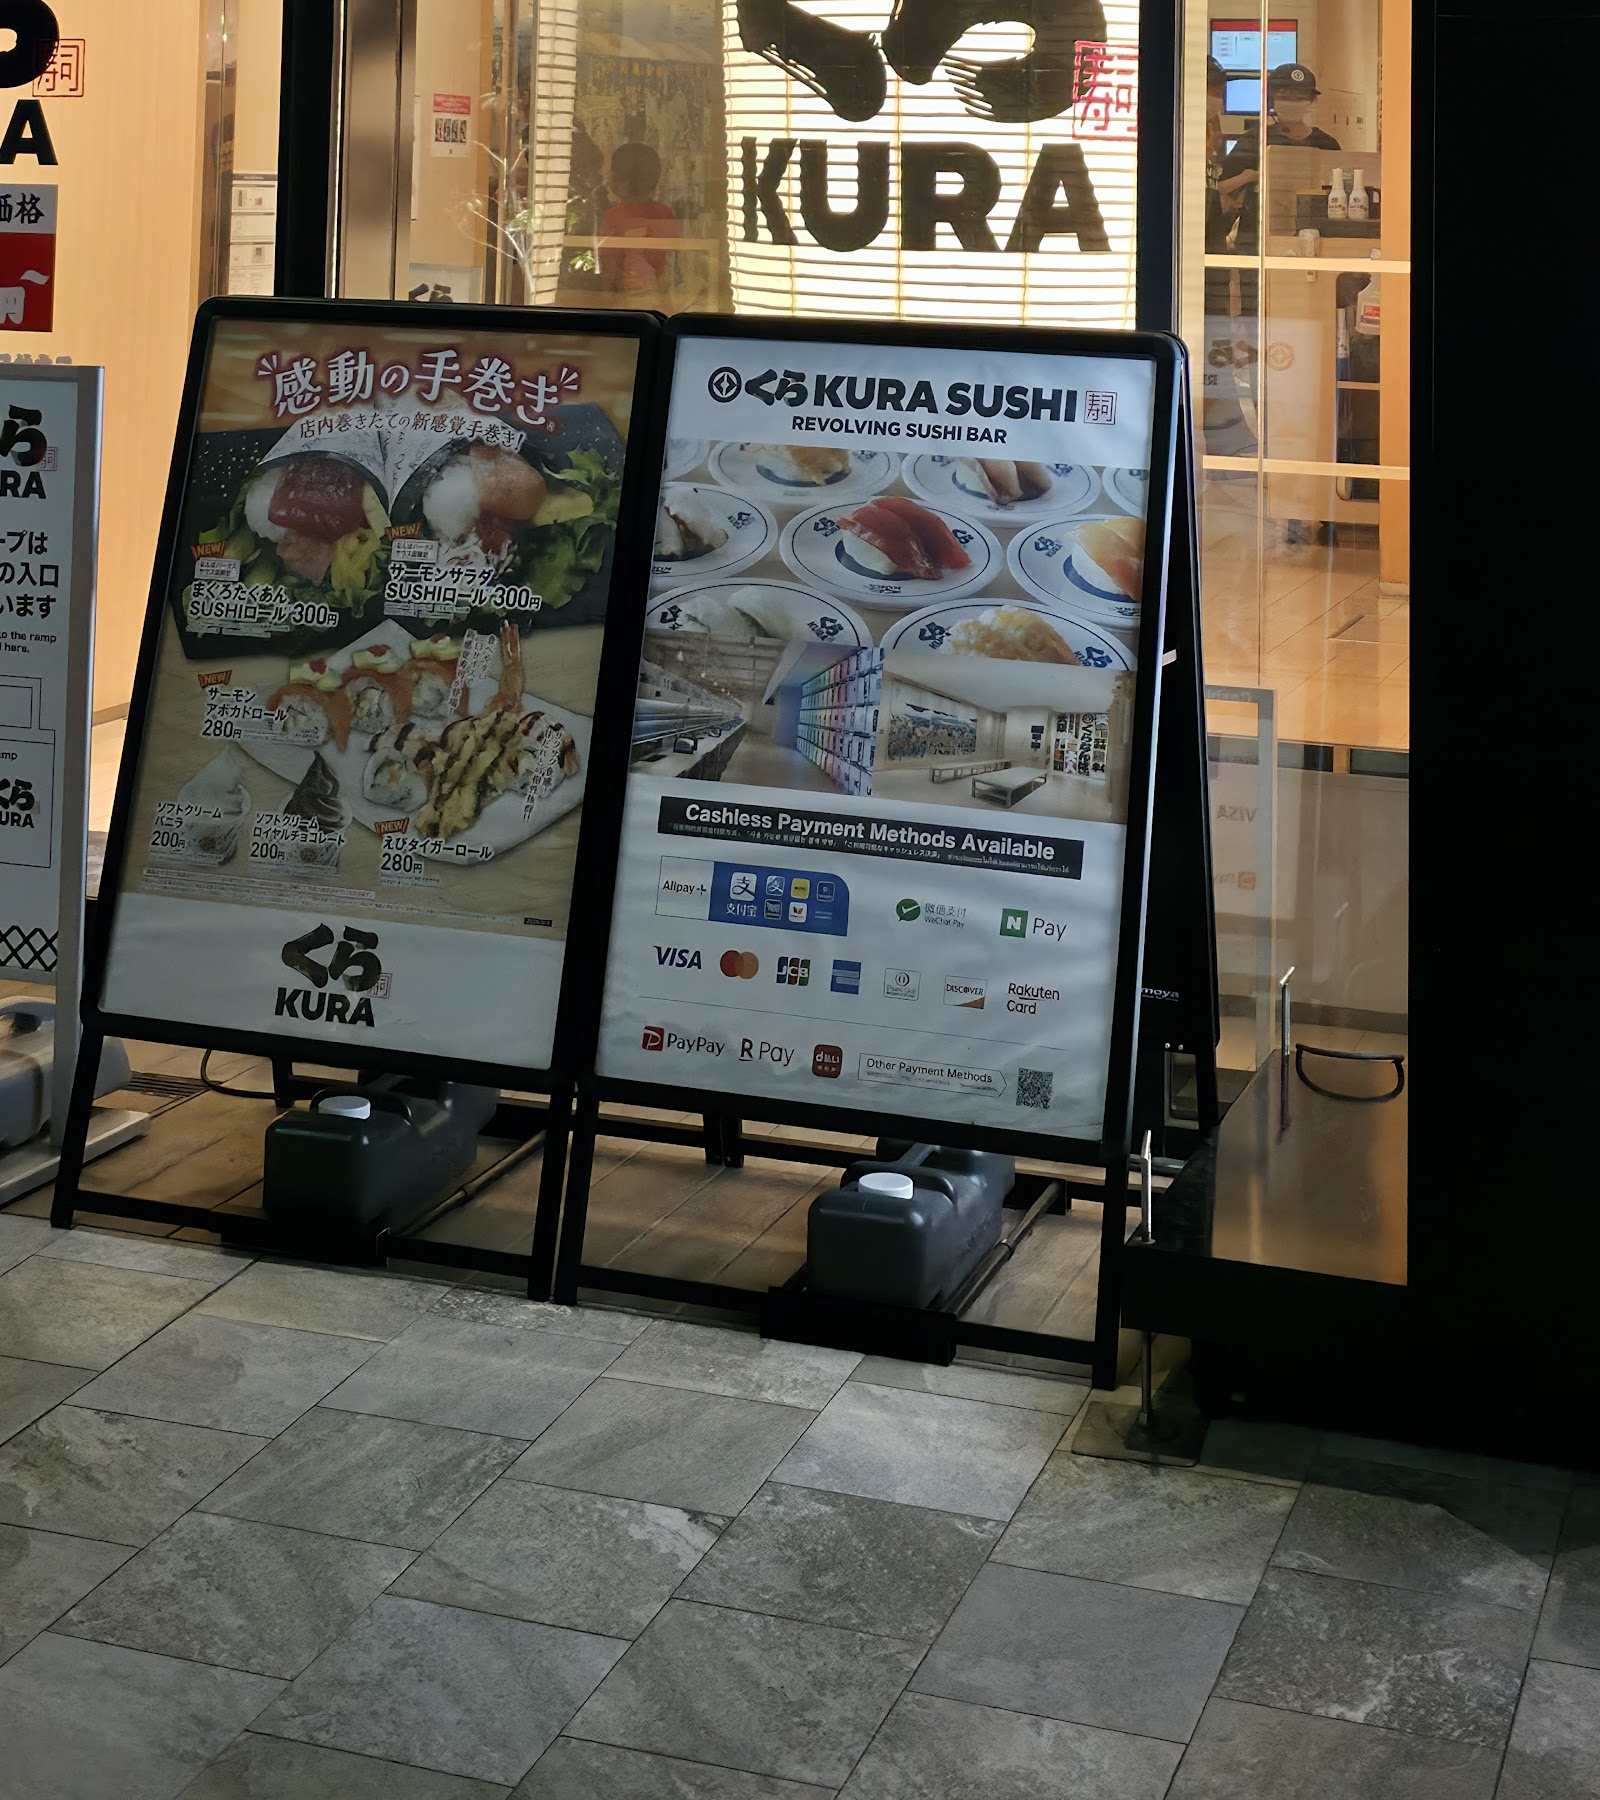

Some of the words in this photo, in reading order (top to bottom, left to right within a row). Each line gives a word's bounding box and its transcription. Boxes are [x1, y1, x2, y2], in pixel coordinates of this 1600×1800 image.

[741, 136, 1111, 253] KURA
[273, 349, 559, 426] 感動の手巻き
[744, 368, 809, 407] くら
[812, 373, 938, 414] KURA
[945, 382, 1078, 422] SUSHI
[792, 415, 901, 437] REVOLVING
[905, 422, 962, 442] SUSHI
[966, 426, 1007, 444] BAR
[390, 563, 494, 586] サーモンサラダ
[192, 581, 288, 604] まぐろたくあん
[386, 583, 486, 606] SUSHIロール
[494, 587, 541, 609] 300円
[189, 601, 287, 622] SUSHIロール
[292, 603, 338, 625] 300円
[10, 632, 27, 641] the
[29, 634, 57, 644] ramp
[208, 687, 256, 703] サーモン
[206, 703, 287, 721] アボカドロール
[202, 719, 242, 739] 280円
[157, 802, 222, 819] ソフトクリーム
[256, 813, 318, 829] ソフトクリーム
[151, 830, 186, 849] 200円
[253, 827, 345, 846] ロイヤルチョコレート
[685, 804, 772, 829] Cashless
[777, 814, 865, 839] Payment
[869, 822, 956, 849] Methods
[961, 833, 1055, 860] Available
[250, 842, 285, 860] 200円
[383, 835, 493, 860] えびタイガーロール
[380, 853, 423, 874] 280円
[726, 902, 758, 918] 支付宝
[924, 915, 951, 926] WeChat
[953, 919, 966, 929] Pay
[1032, 917, 1067, 941] Pay
[282, 922, 382, 993] くら
[653, 945, 702, 969] VISA
[776, 965, 810, 978] JCB
[946, 983, 984, 996] DISCOVER
[1008, 982, 1060, 1000] Rakuten
[274, 987, 375, 1027] KURA
[1006, 1000, 1037, 1015] Card
[667, 1032, 725, 1057] PayPay
[759, 1041, 795, 1067] Pay
[866, 1058, 896, 1070] Other
[899, 1062, 944, 1077] Payment
[947, 1068, 993, 1083] Methods
